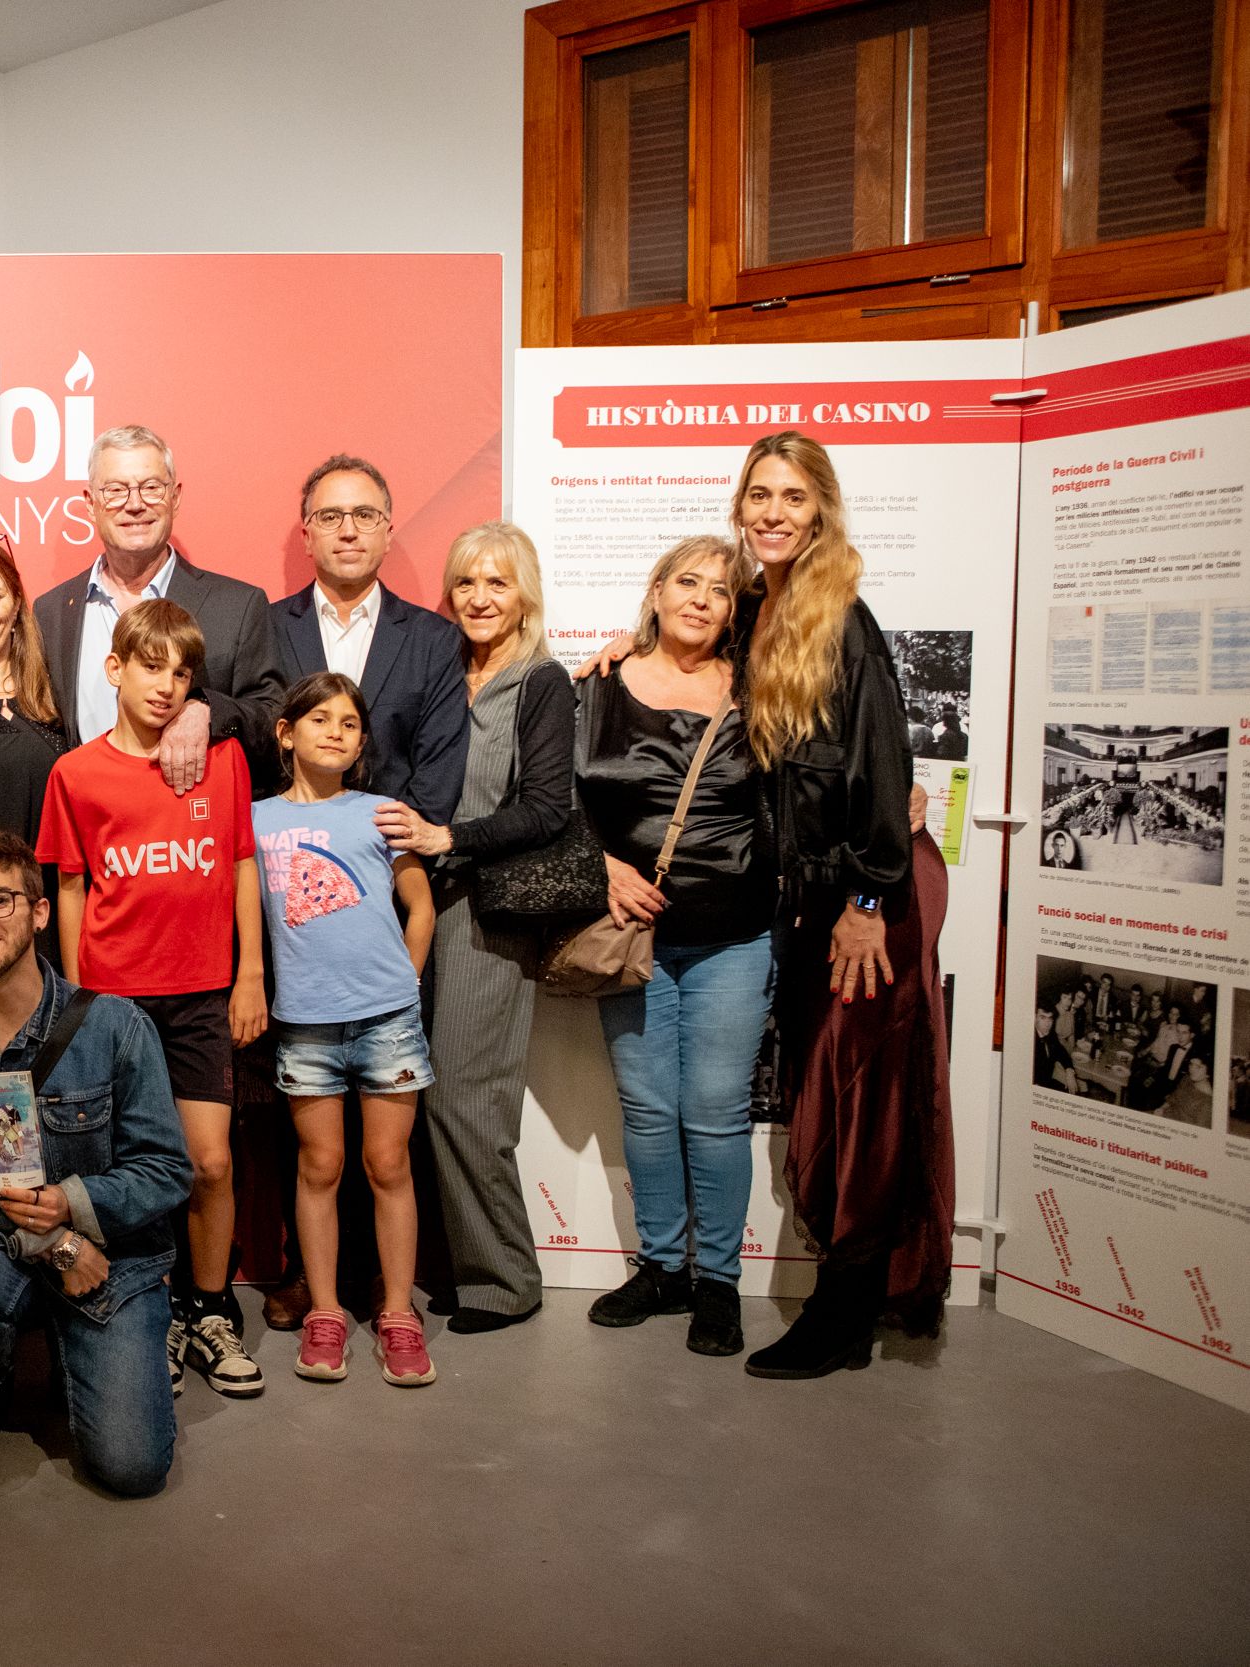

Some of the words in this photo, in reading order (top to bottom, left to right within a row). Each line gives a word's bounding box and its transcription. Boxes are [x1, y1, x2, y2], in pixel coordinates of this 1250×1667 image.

[586, 400, 741, 426] HISTÒRIA
[745, 404, 807, 424] DEL
[812, 402, 931, 423] CASINO
[1096, 462, 1110, 472] de
[1113, 460, 1124, 470] la
[1127, 455, 1166, 468] Guerra
[1170, 449, 1196, 462] Civil
[1199, 448, 1204, 459] i
[602, 475, 607, 486] i
[610, 475, 653, 486] entitat
[657, 475, 731, 486] fundacional
[1052, 478, 1110, 495] postguerra
[1139, 555, 1156, 564] 1942
[1216, 560, 1240, 568] Casino
[548, 628, 597, 638] L'actual
[104, 836, 215, 880] AVENÇ
[1038, 905, 1071, 918] Funció
[1074, 911, 1106, 923] social
[1109, 916, 1123, 926] en
[1126, 918, 1179, 934] moments
[1182, 925, 1197, 936] de
[1201, 928, 1228, 941] crisi
[1059, 940, 1076, 949] refugi
[1142, 943, 1167, 953] Rierada
[1169, 947, 1180, 955] del
[1182, 949, 1192, 957] 25
[1193, 950, 1202, 958] de
[1204, 952, 1237, 963] setembre
[1031, 1120, 1098, 1148] Rehabilitació
[1107, 1142, 1162, 1166] titularitat
[1164, 1159, 1208, 1179] pública
[547, 1199, 558, 1211] del
[1047, 1188, 1061, 1216] Guerra
[548, 1235, 579, 1245] 1863
[746, 1227, 754, 1238] de
[740, 1243, 762, 1253] 893
[1106, 1236, 1121, 1265] Casino
[1055, 1279, 1081, 1297] 1936
[1116, 1302, 1146, 1322] 1942
[1201, 1334, 1232, 1354] 1962
